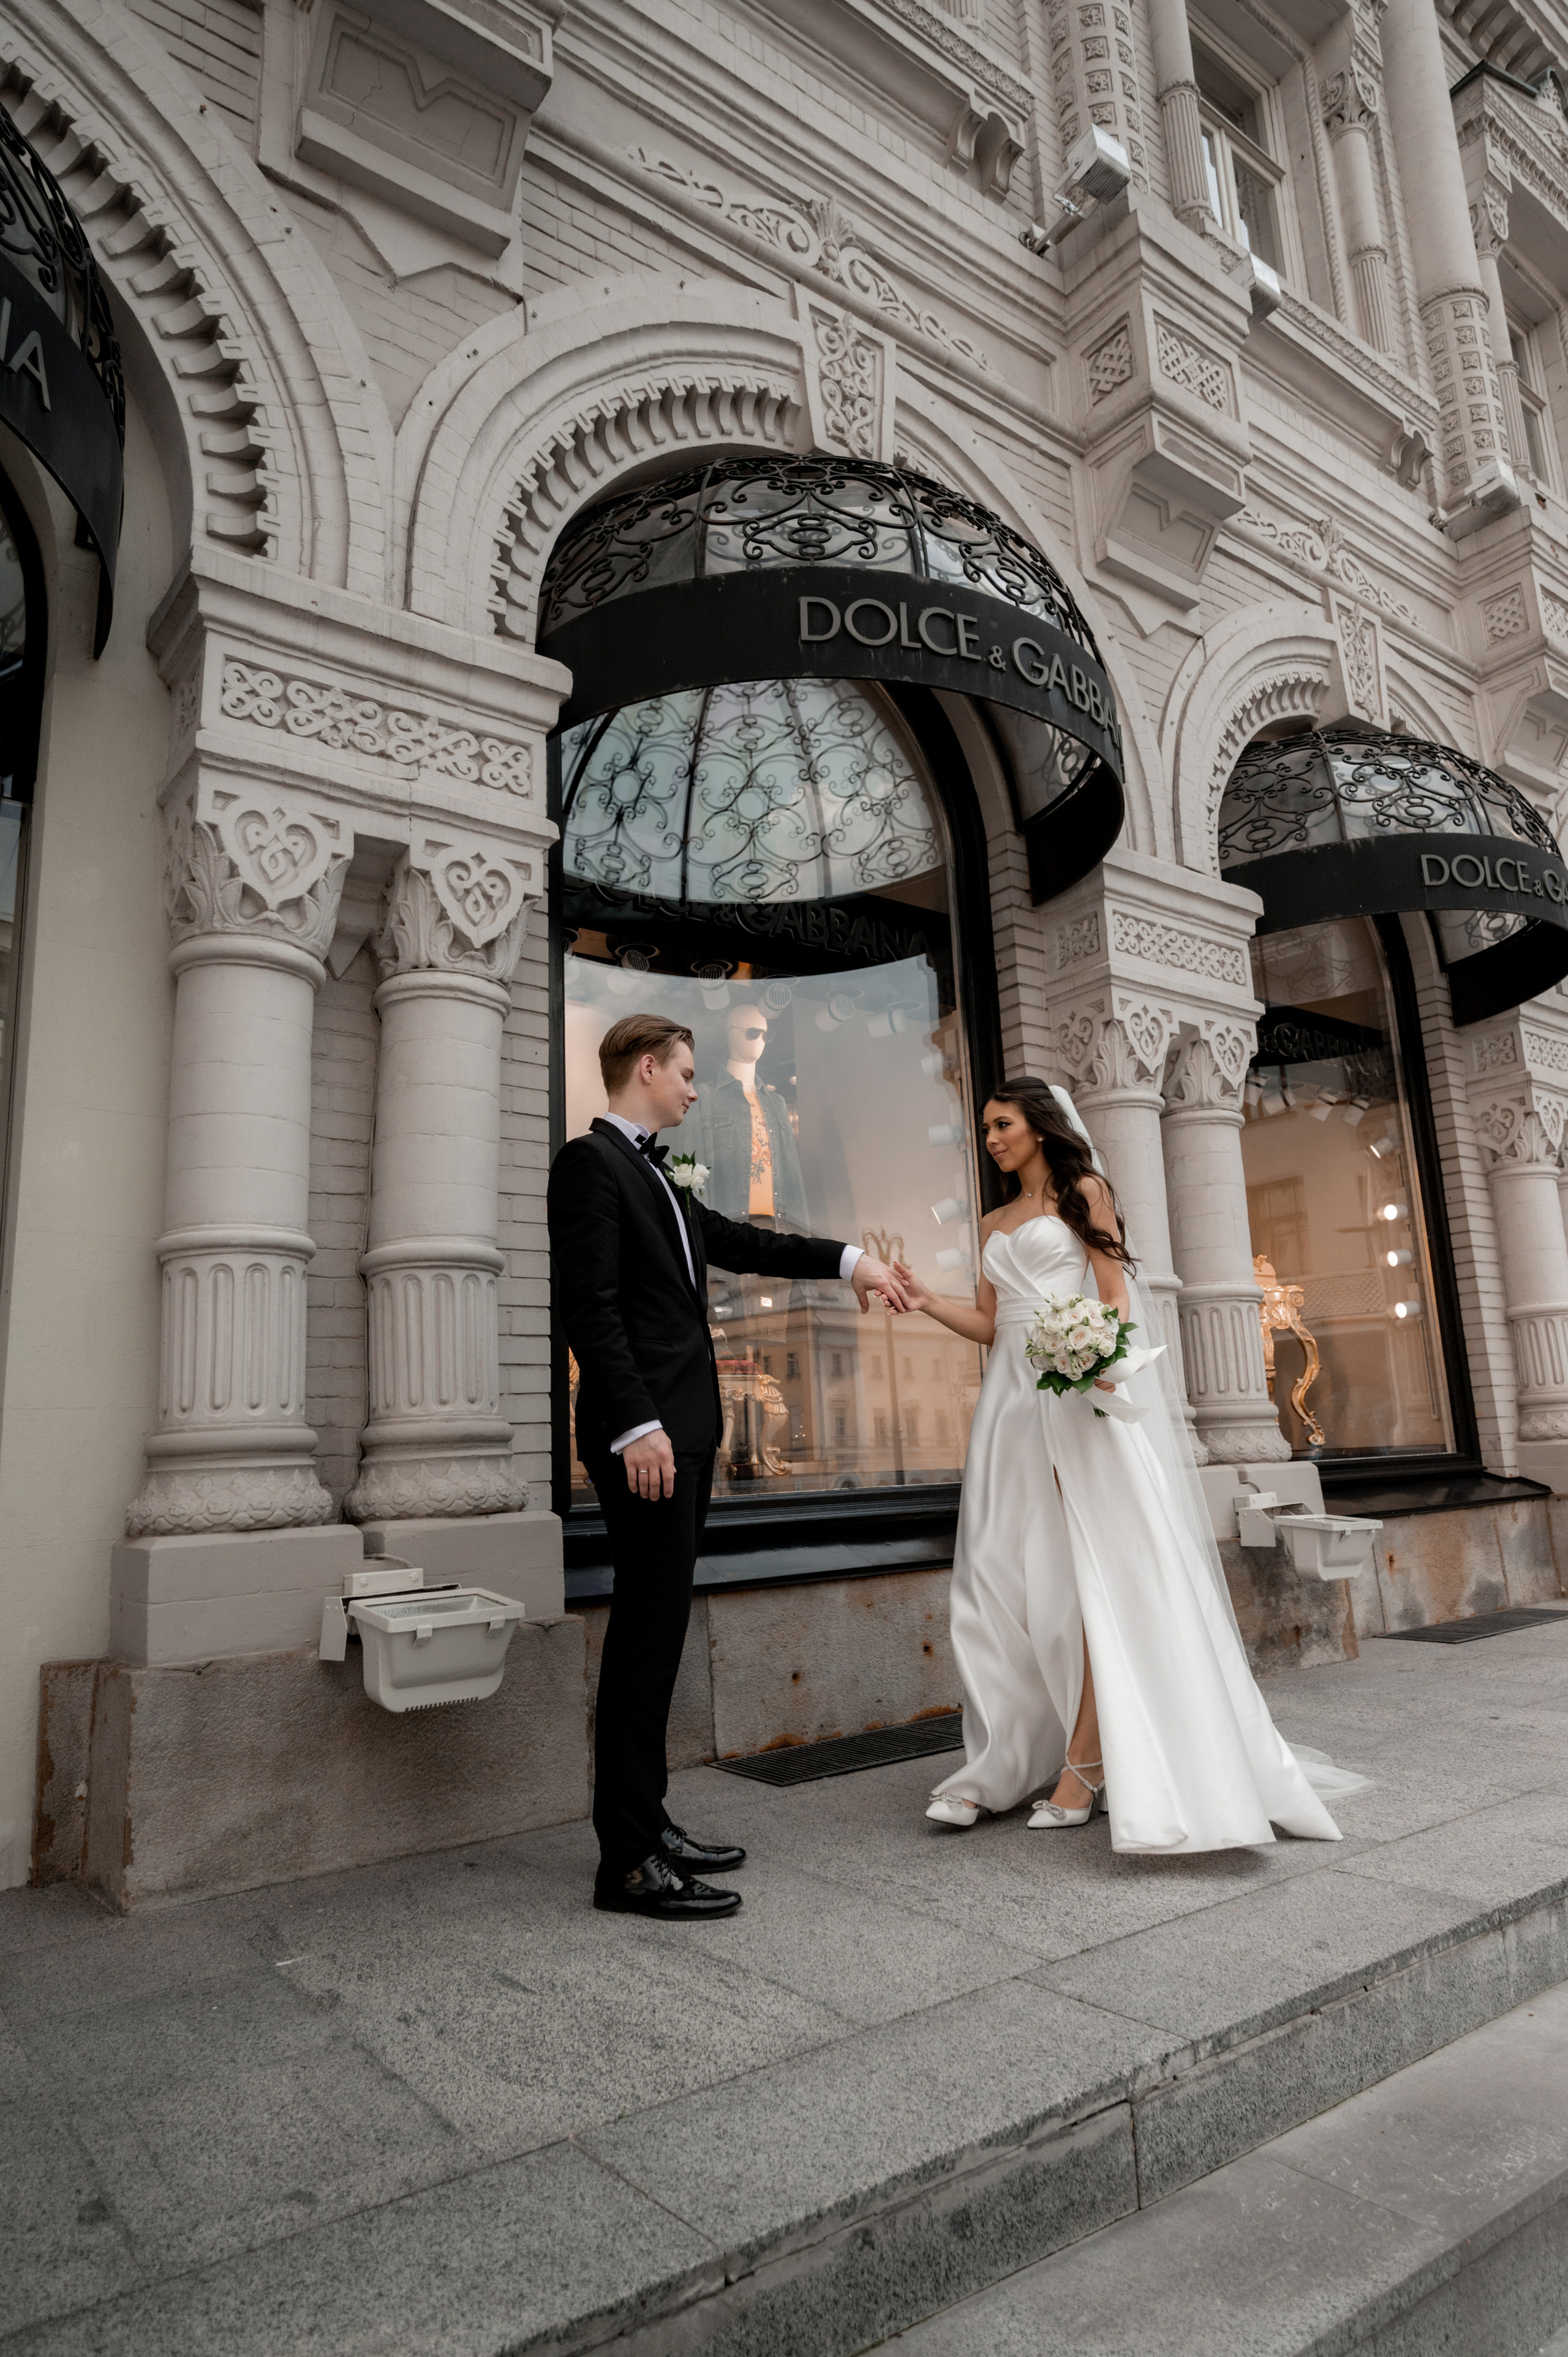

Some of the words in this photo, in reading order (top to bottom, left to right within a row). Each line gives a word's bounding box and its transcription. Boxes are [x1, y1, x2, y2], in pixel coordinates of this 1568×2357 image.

[799, 596, 982, 662] DOLCE
[988, 645, 1007, 672] &
[1011, 637, 1126, 784] GABBA
[1420, 853, 1531, 895] DOLCE
[1533, 879, 1544, 897] &
